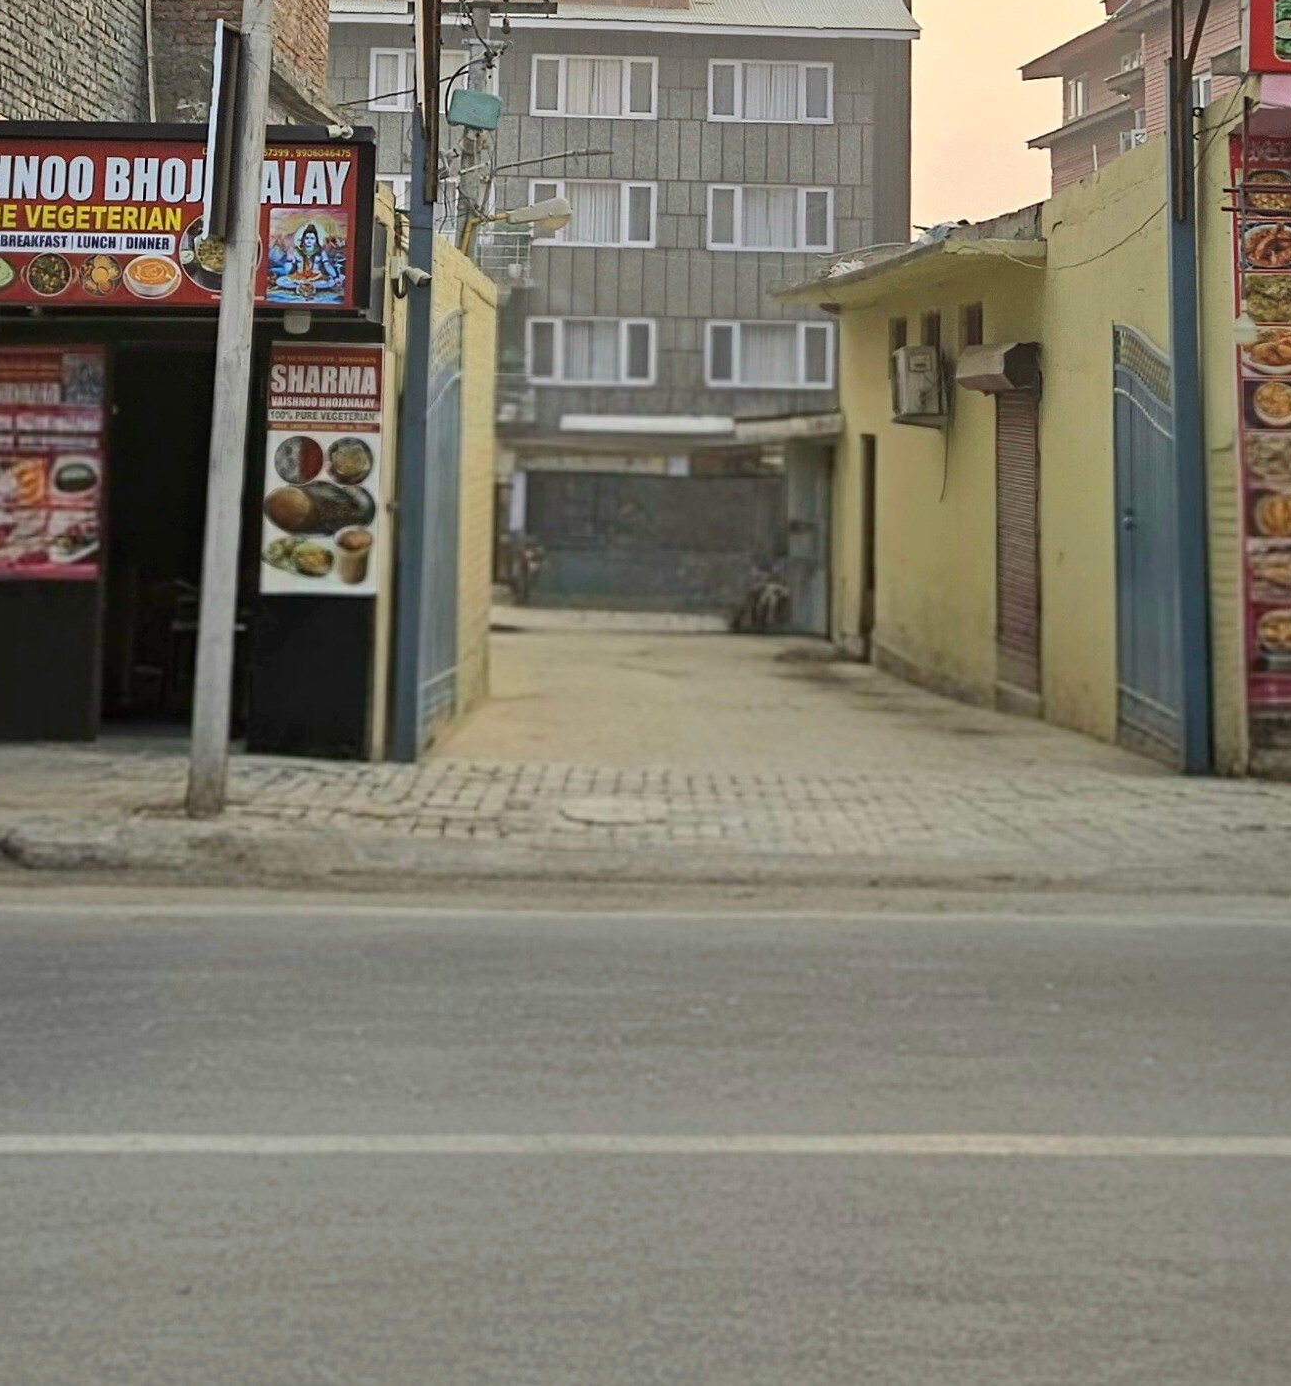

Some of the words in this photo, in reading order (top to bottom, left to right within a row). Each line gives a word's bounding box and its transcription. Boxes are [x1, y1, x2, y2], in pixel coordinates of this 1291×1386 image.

[104, 156, 351, 206] BHOJALAY
[25, 204, 182, 231] VEGETERIAN
[0, 234, 68, 249] BREAKFAST
[76, 236, 117, 250] LUNCH
[125, 236, 169, 251] DINNER
[270, 364, 377, 395] SHARMA
[271, 396, 318, 407] VAISHNOO
[319, 397, 376, 409] BHOJANALAY
[270, 411, 293, 420] 100%
[295, 411, 318, 420] PURE
[320, 412, 375, 421] VEGETERIAN
